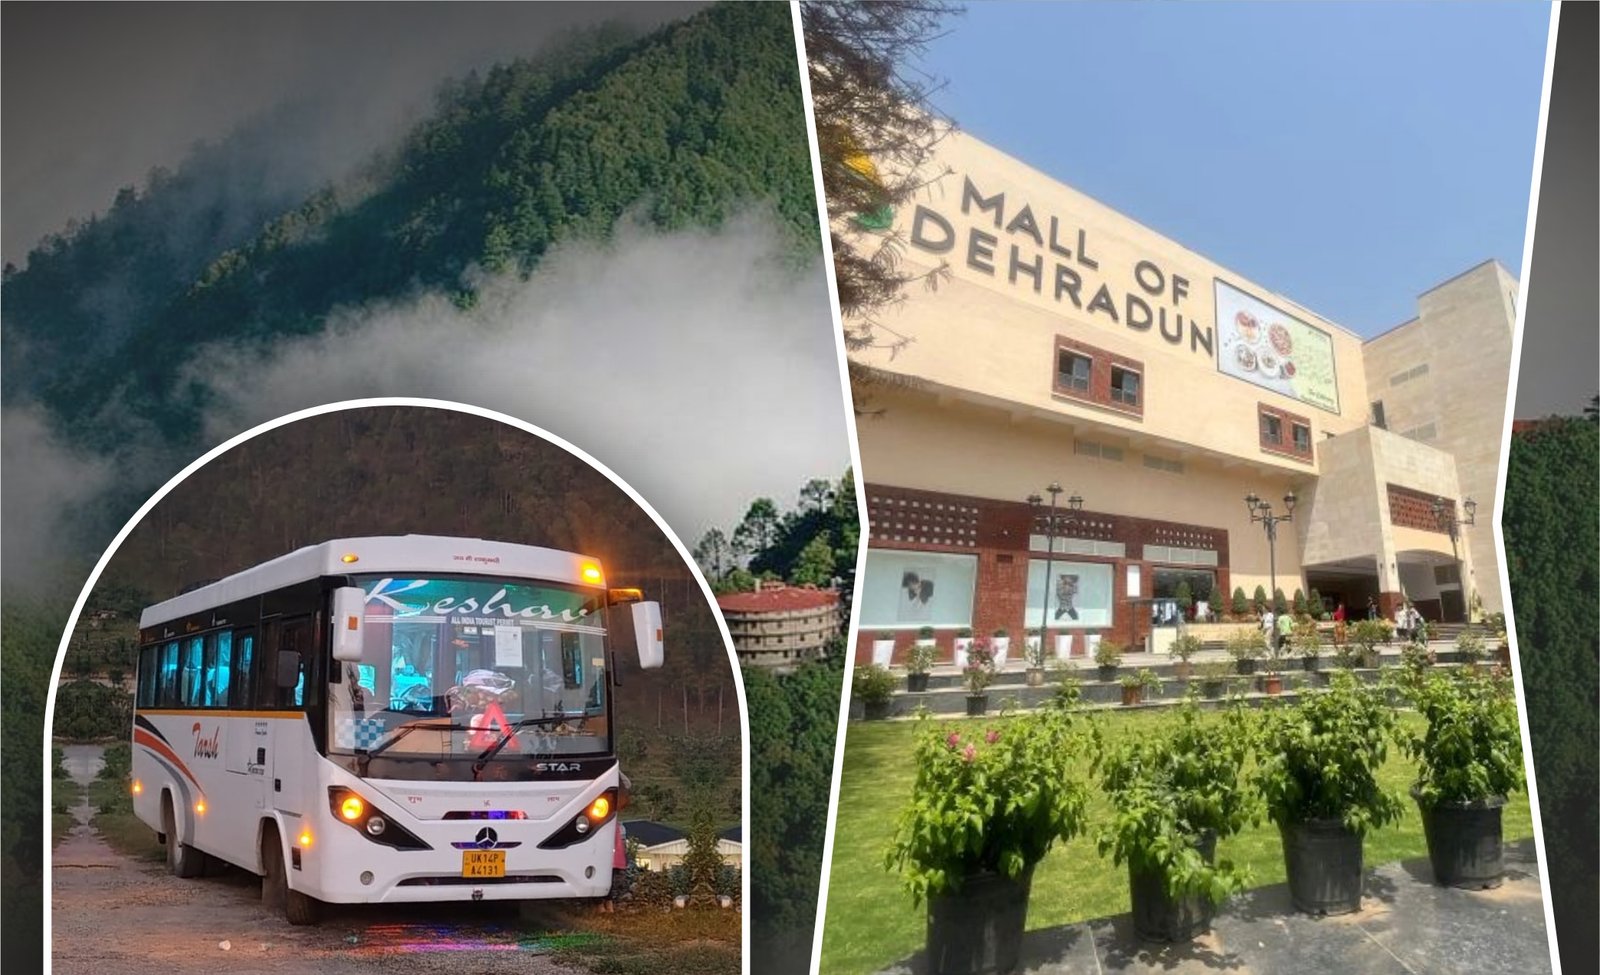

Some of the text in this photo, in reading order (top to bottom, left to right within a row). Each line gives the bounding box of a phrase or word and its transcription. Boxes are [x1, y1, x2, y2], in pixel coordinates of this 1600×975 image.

[960, 174, 1190, 306] MALL OF
[910, 204, 1214, 358] DEHRADUN
[364, 578, 588, 622] Keshav
[451, 616, 514, 627] ALL INDIA TOURIST PERMIT
[536, 763, 582, 772] STAR
[471, 854, 499, 863] UK14P
[471, 865, 499, 875] A4131
